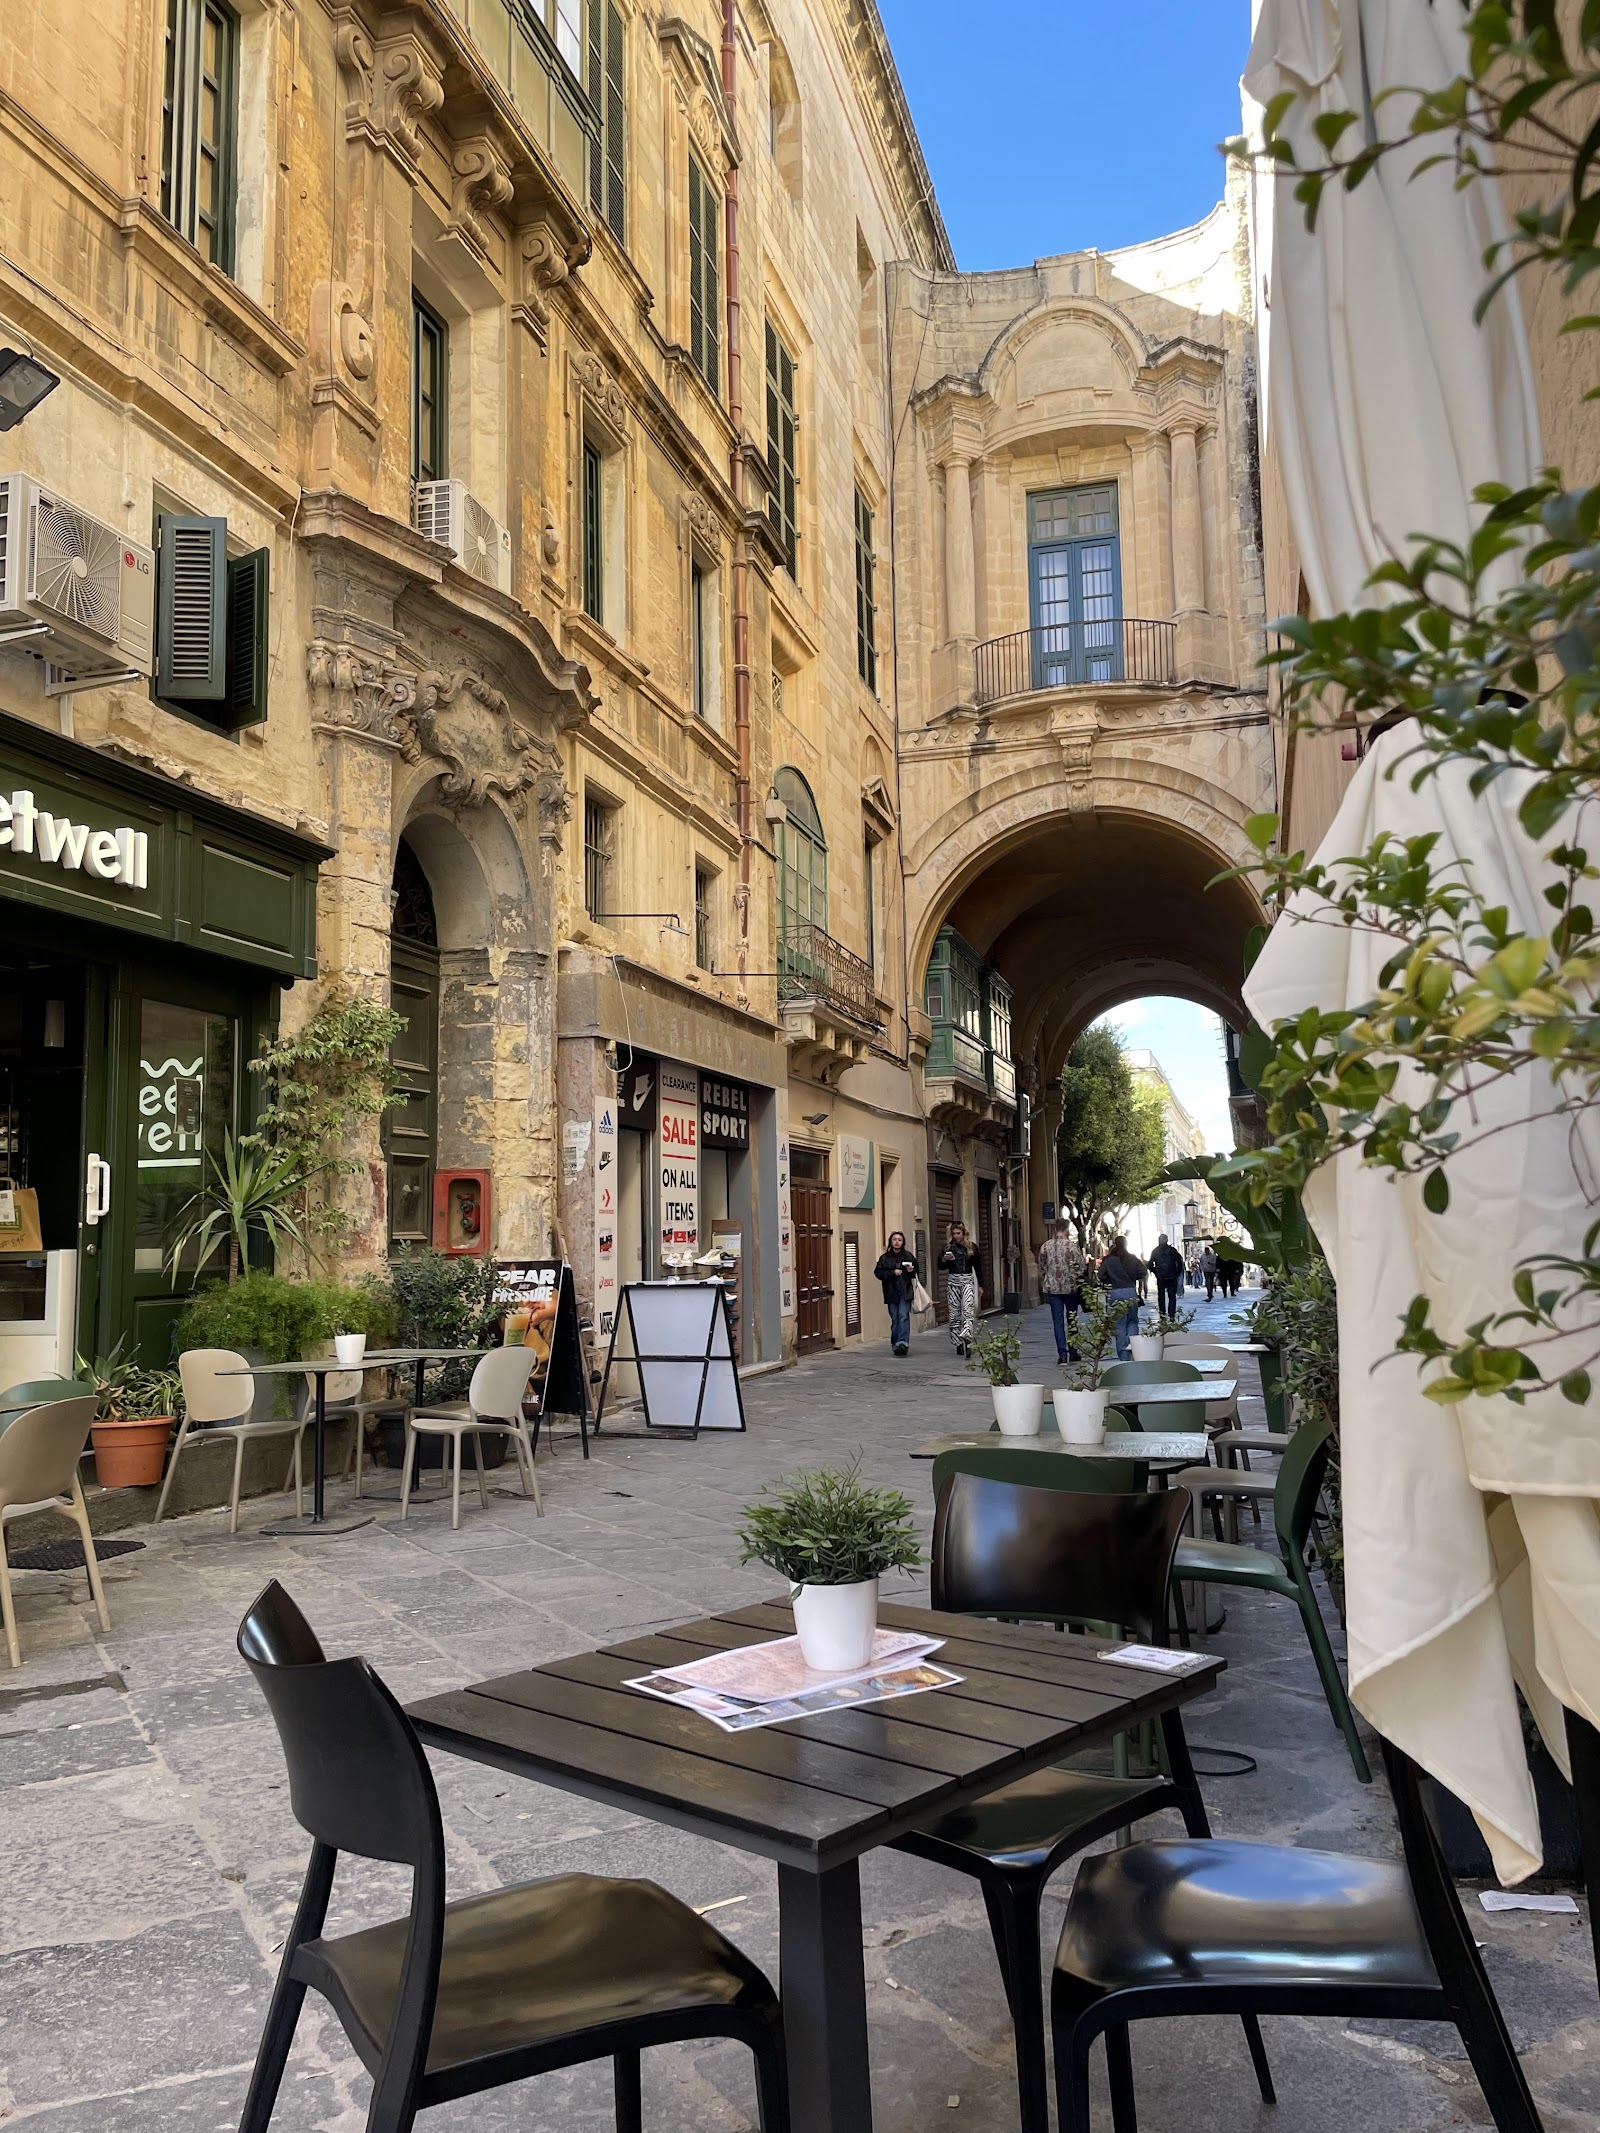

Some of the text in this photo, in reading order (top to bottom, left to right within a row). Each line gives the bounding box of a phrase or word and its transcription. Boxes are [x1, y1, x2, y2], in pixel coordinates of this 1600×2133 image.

[136, 559, 149, 575] LG
[662, 1075, 696, 1093] CLEARANCE
[703, 1081, 747, 1111] REBEL
[662, 1115, 696, 1146] SALE
[703, 1111, 747, 1139] SPORT
[662, 1168, 697, 1189] ON ALL
[665, 1202, 694, 1221] ITEMS
[491, 1286, 554, 1302] PRESSURE
